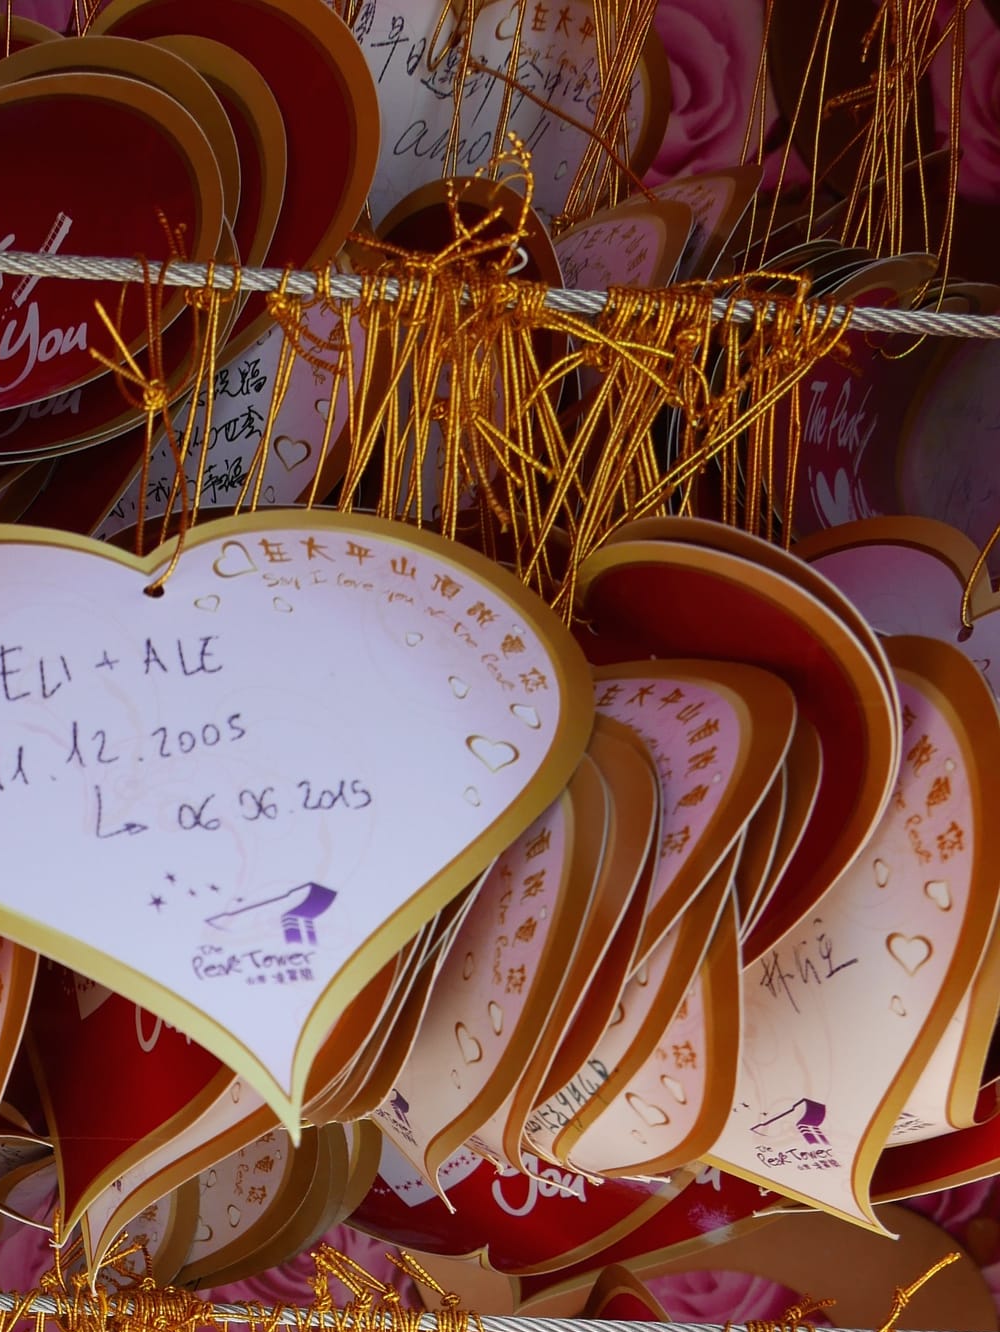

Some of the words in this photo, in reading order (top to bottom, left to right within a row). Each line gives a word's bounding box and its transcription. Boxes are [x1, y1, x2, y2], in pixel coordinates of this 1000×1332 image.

[804, 378, 829, 445] The
[827, 377, 873, 453] Peak
[144, 636, 223, 676] ALE
[242, 950, 316, 969] Tower
[757, 1151, 793, 1168] Peak
[788, 1148, 832, 1161] Tower
